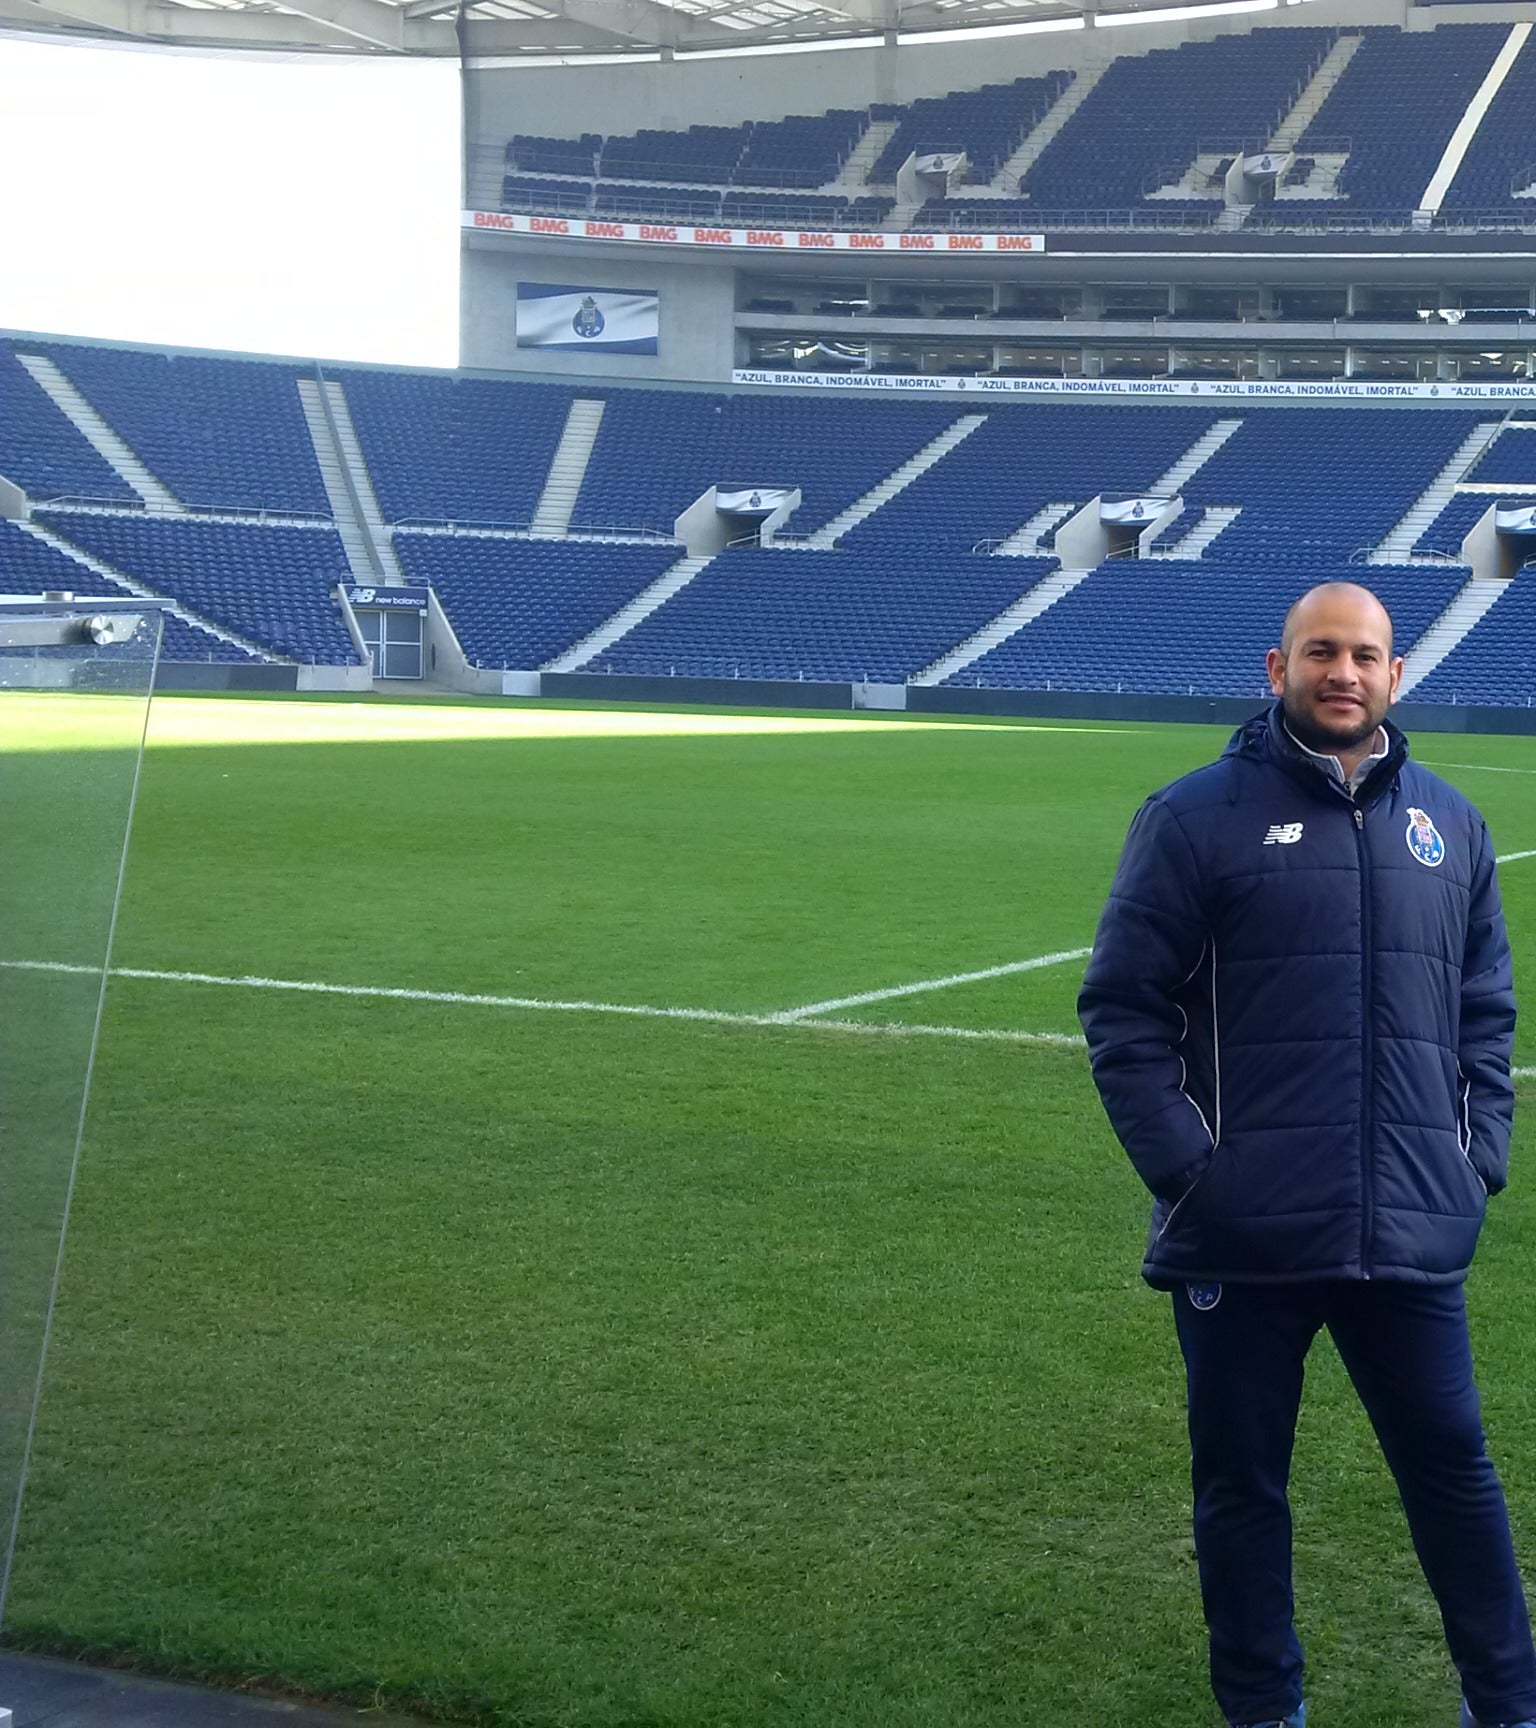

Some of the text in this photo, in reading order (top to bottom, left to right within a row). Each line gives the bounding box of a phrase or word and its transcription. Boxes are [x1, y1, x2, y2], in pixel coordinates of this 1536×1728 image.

[474, 212, 1032, 250] BMG BMG BMG BMG BMG BMG BMG BMG BMG BMG BMG
[775, 375, 824, 385] BRANCA,
[826, 375, 894, 387] INDOMÁVEL,
[1014, 381, 1061, 391] BRANCA,
[1062, 381, 1128, 392] INDOMÁVEL,
[1247, 385, 1296, 394] BRANCA,
[1297, 384, 1365, 395] INDOMÁVEL,
[375, 597, 392, 605] new
[393, 597, 426, 605] balance
